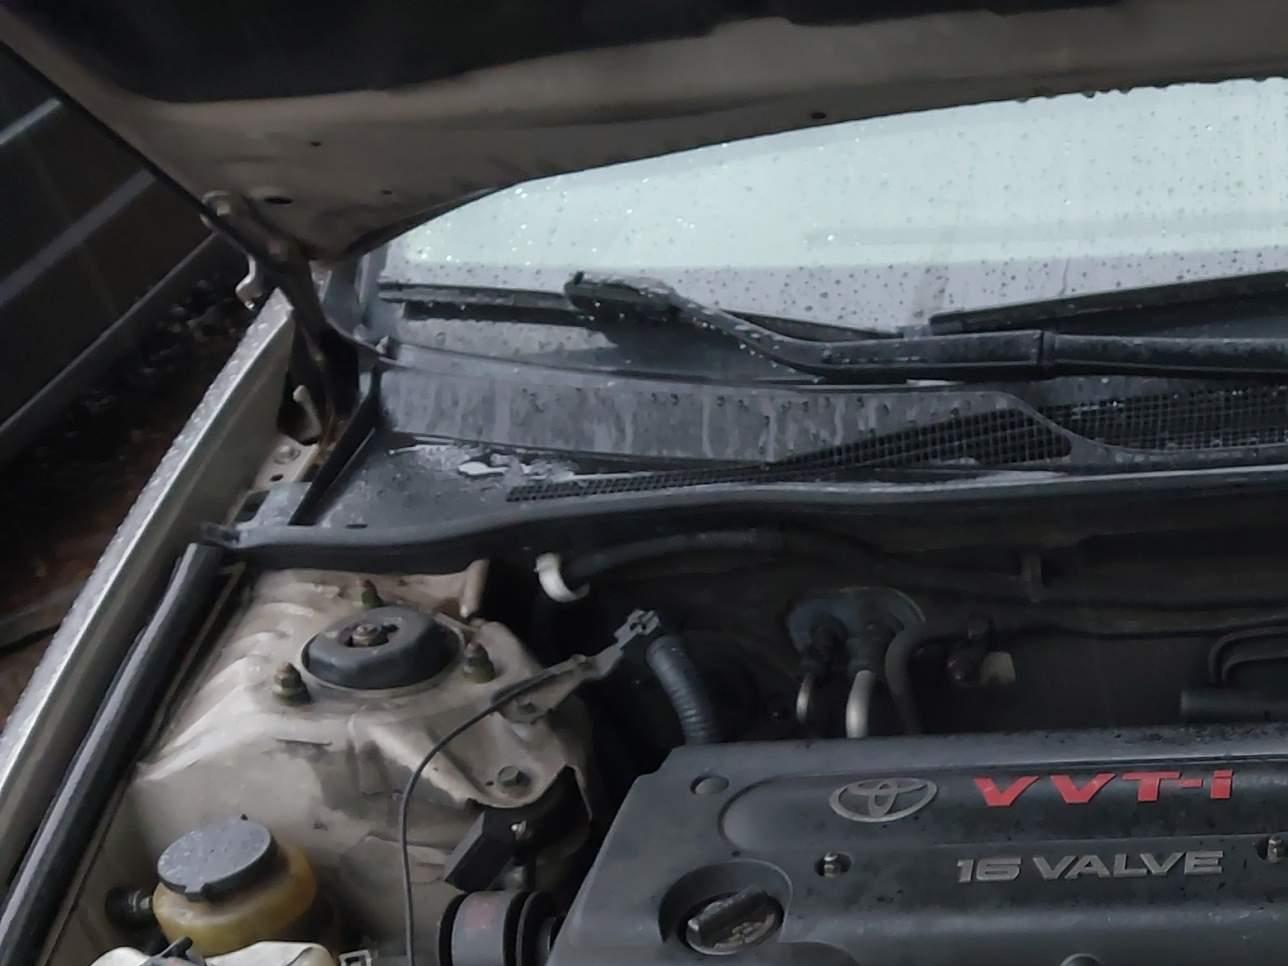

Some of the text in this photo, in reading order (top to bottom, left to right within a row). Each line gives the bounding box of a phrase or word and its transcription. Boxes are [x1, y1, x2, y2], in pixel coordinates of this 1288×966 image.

[974, 770, 1233, 807] VVT-i
[957, 850, 1224, 882] 16 VALVE
